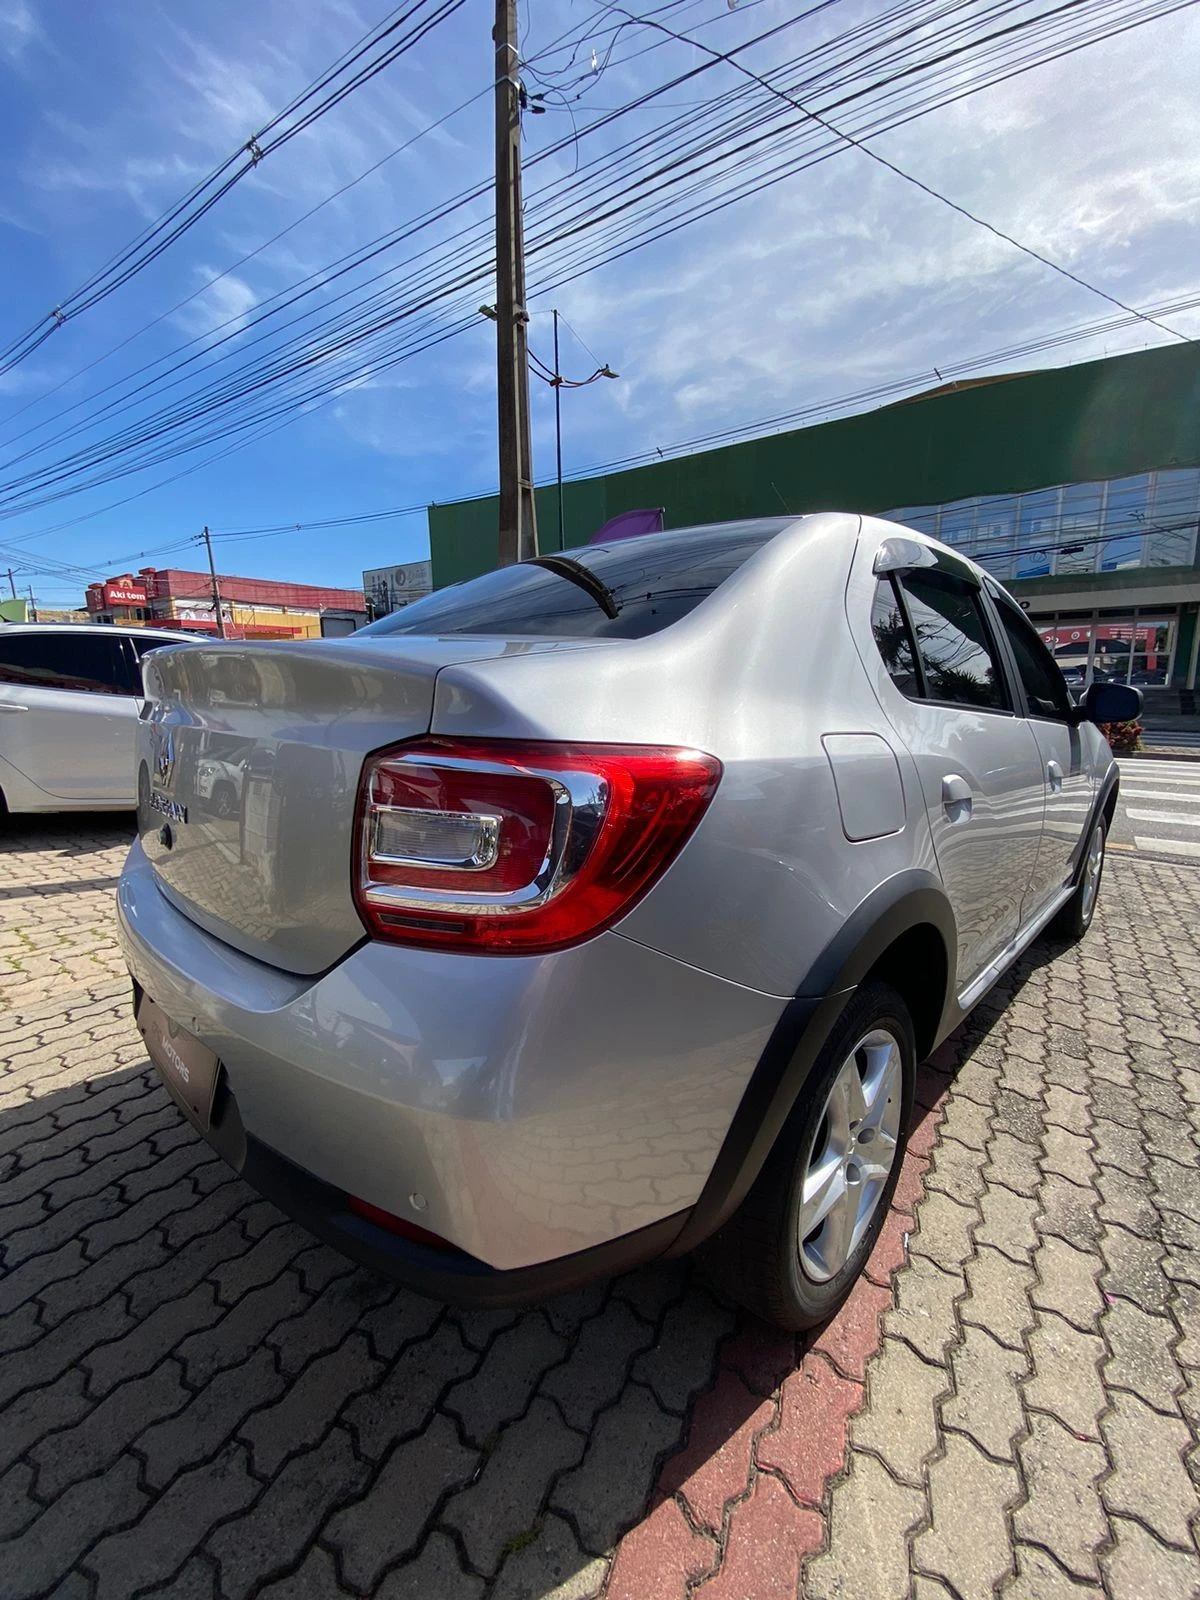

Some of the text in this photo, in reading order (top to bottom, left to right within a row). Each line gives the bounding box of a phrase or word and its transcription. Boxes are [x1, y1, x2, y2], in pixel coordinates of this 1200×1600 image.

[109, 591, 146, 601] Aki tem
[161, 1035, 190, 1084] MOTORS
